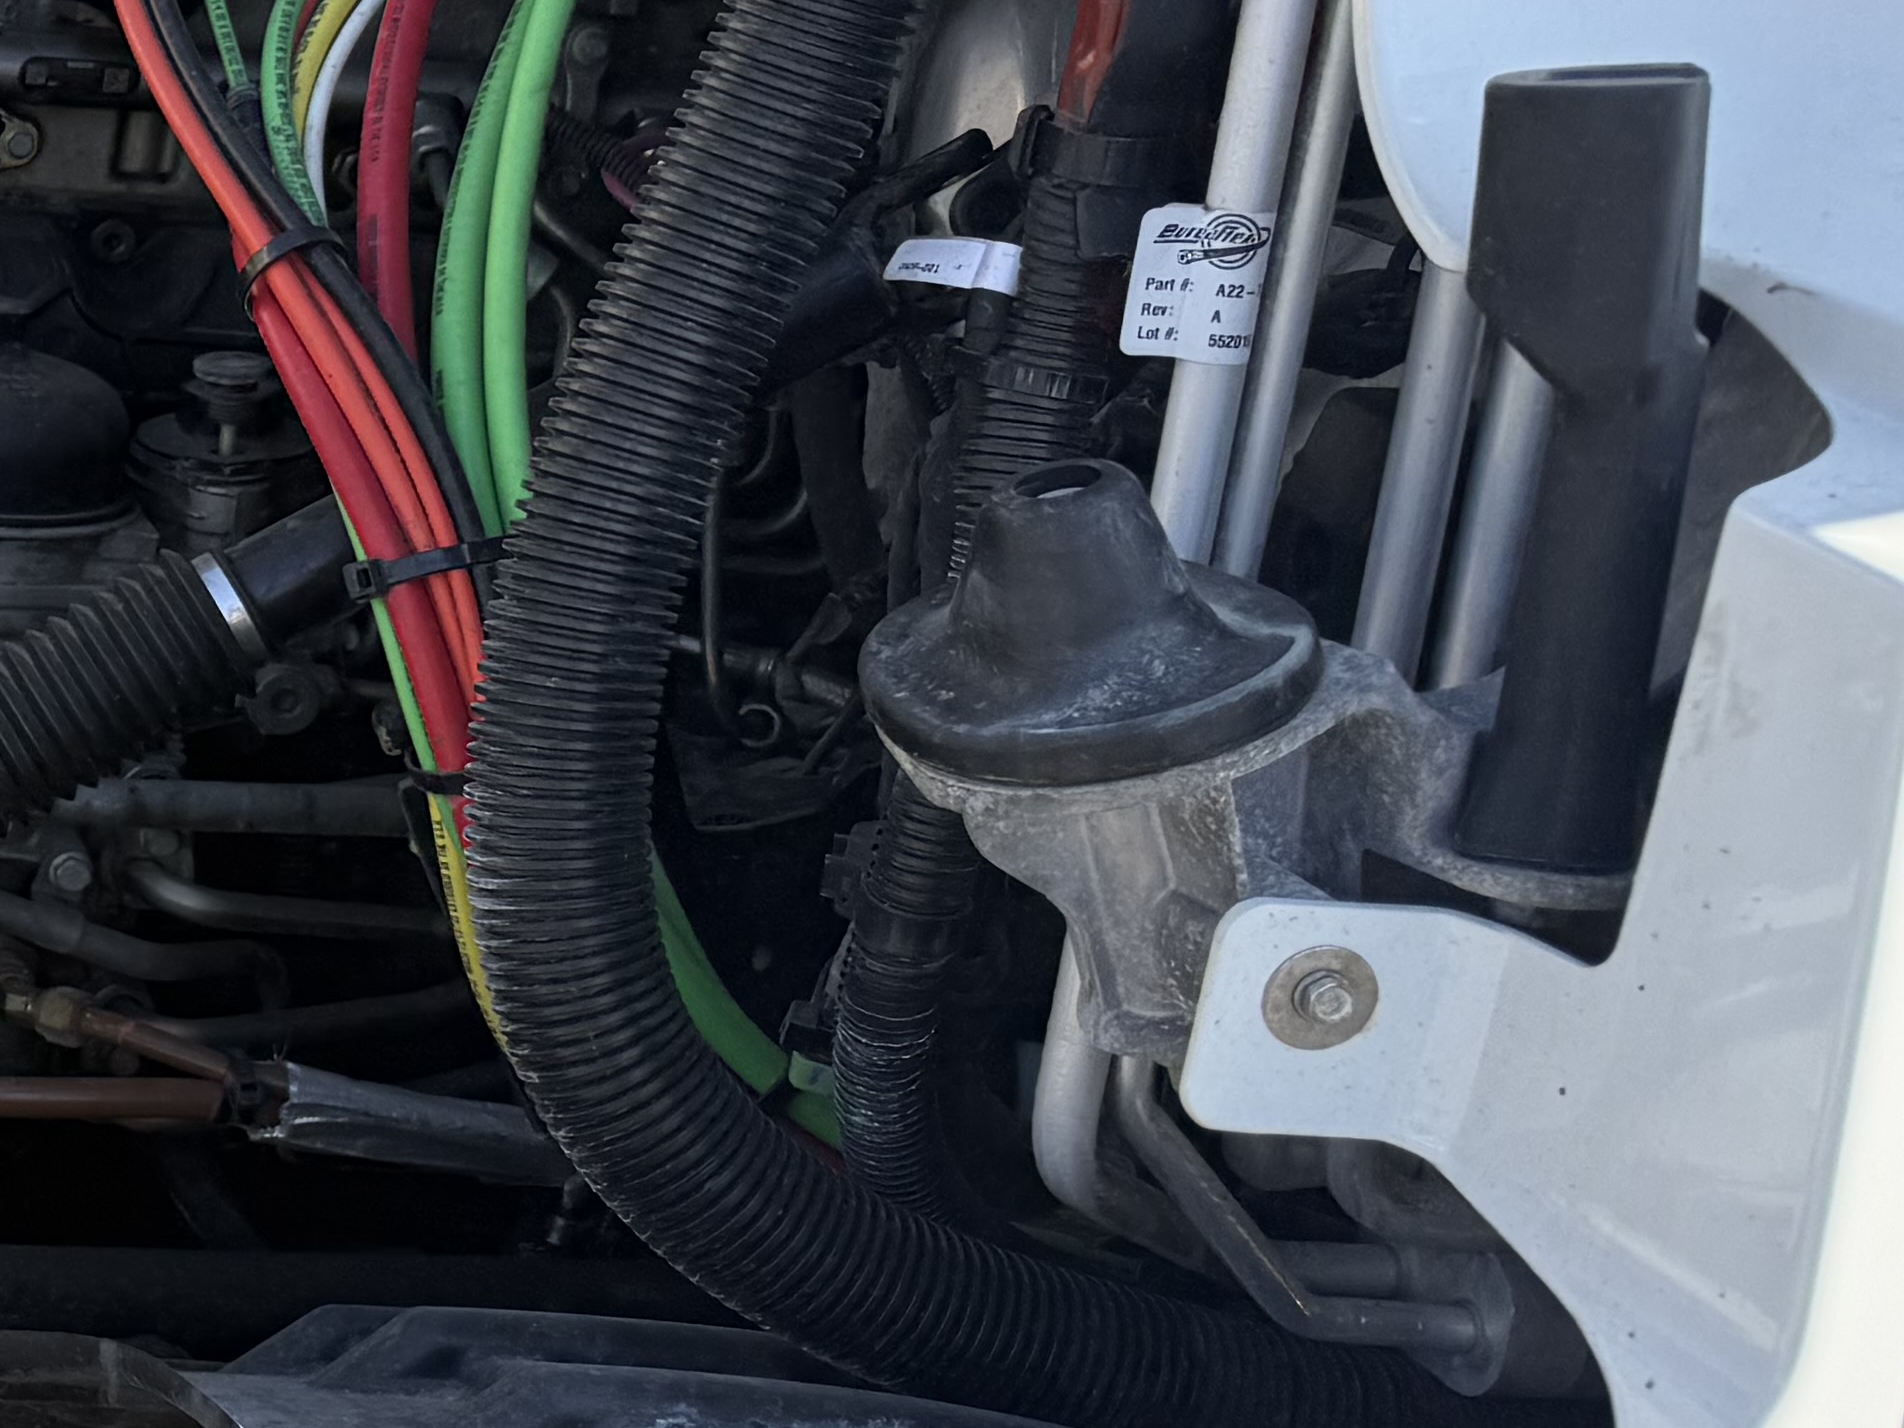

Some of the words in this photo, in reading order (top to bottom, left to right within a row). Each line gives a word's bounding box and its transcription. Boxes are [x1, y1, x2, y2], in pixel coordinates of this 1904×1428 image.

[1145, 277, 1175, 291] Part
[1140, 302, 1173, 316] Rev:
[1211, 310, 1221, 324] A
[1137, 326, 1159, 340] Lot
